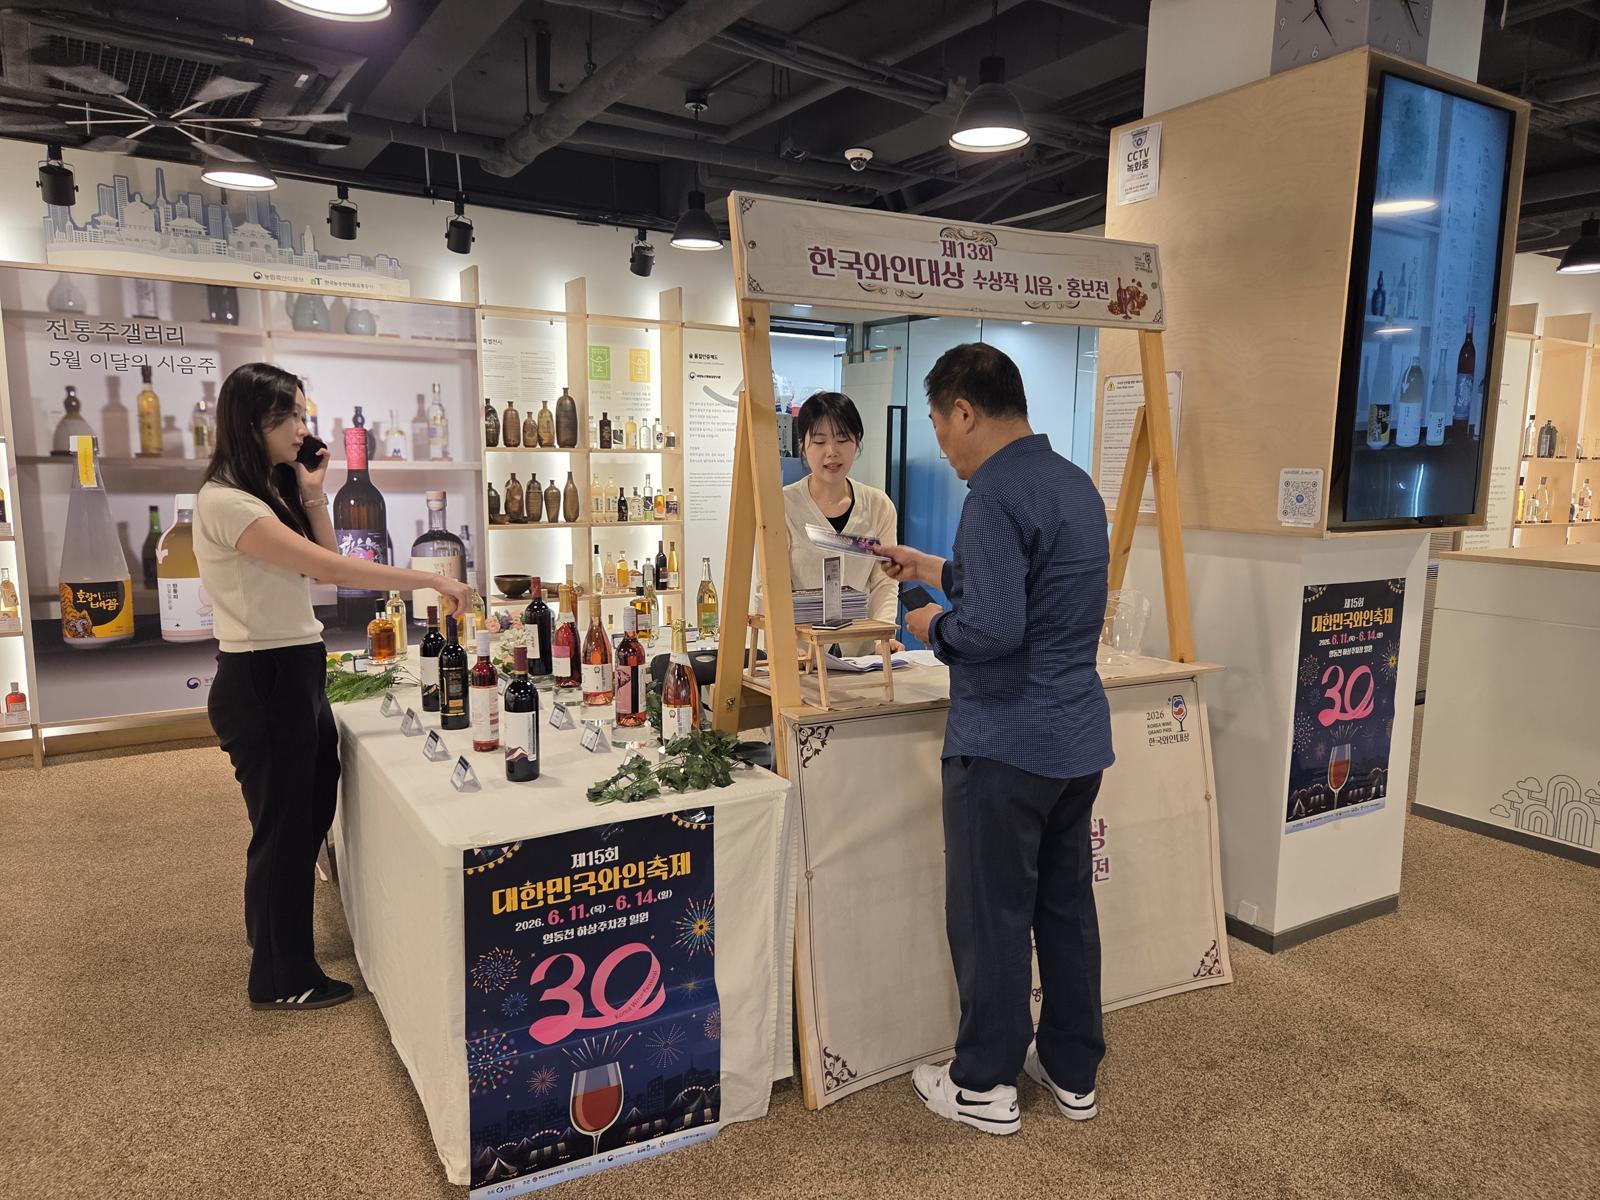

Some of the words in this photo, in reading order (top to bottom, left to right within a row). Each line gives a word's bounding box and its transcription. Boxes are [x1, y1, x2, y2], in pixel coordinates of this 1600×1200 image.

[1279, 17, 1287, 31] 9
[1311, 46, 1319, 58] 6
[1127, 147, 1150, 162] CCTV
[1127, 158, 1149, 172] 녹화중
[939, 239, 995, 263] 제13회
[807, 246, 966, 290] 한국와인대상
[973, 269, 1019, 293] 수상작
[1024, 274, 1053, 297] 시음
[1066, 278, 1110, 301] 홍보전
[46, 319, 185, 346] 전통주갤러리
[49, 350, 82, 370] 5월
[90, 352, 149, 372] 이달의
[157, 355, 217, 375] 시음주
[76, 589, 101, 603] 호랑이
[1343, 597, 1365, 609] 제15회
[1311, 607, 1394, 633] 대한민국와인축제
[1318, 664, 1375, 727] 30
[1145, 710, 1165, 721] 2026
[1148, 732, 1190, 747] 한국와인대상
[570, 845, 620, 870] 제15회
[1092, 857, 1110, 883] 전
[491, 850, 692, 916] 대한민국와인축제
[514, 917, 545, 932] 2026.
[547, 908, 565, 926] 6.
[615, 894, 632, 911] 6.
[542, 927, 575, 945] 영동천
[576, 917, 628, 938] 하상주차장
[629, 911, 650, 927] 일원
[528, 942, 666, 1045] 30
